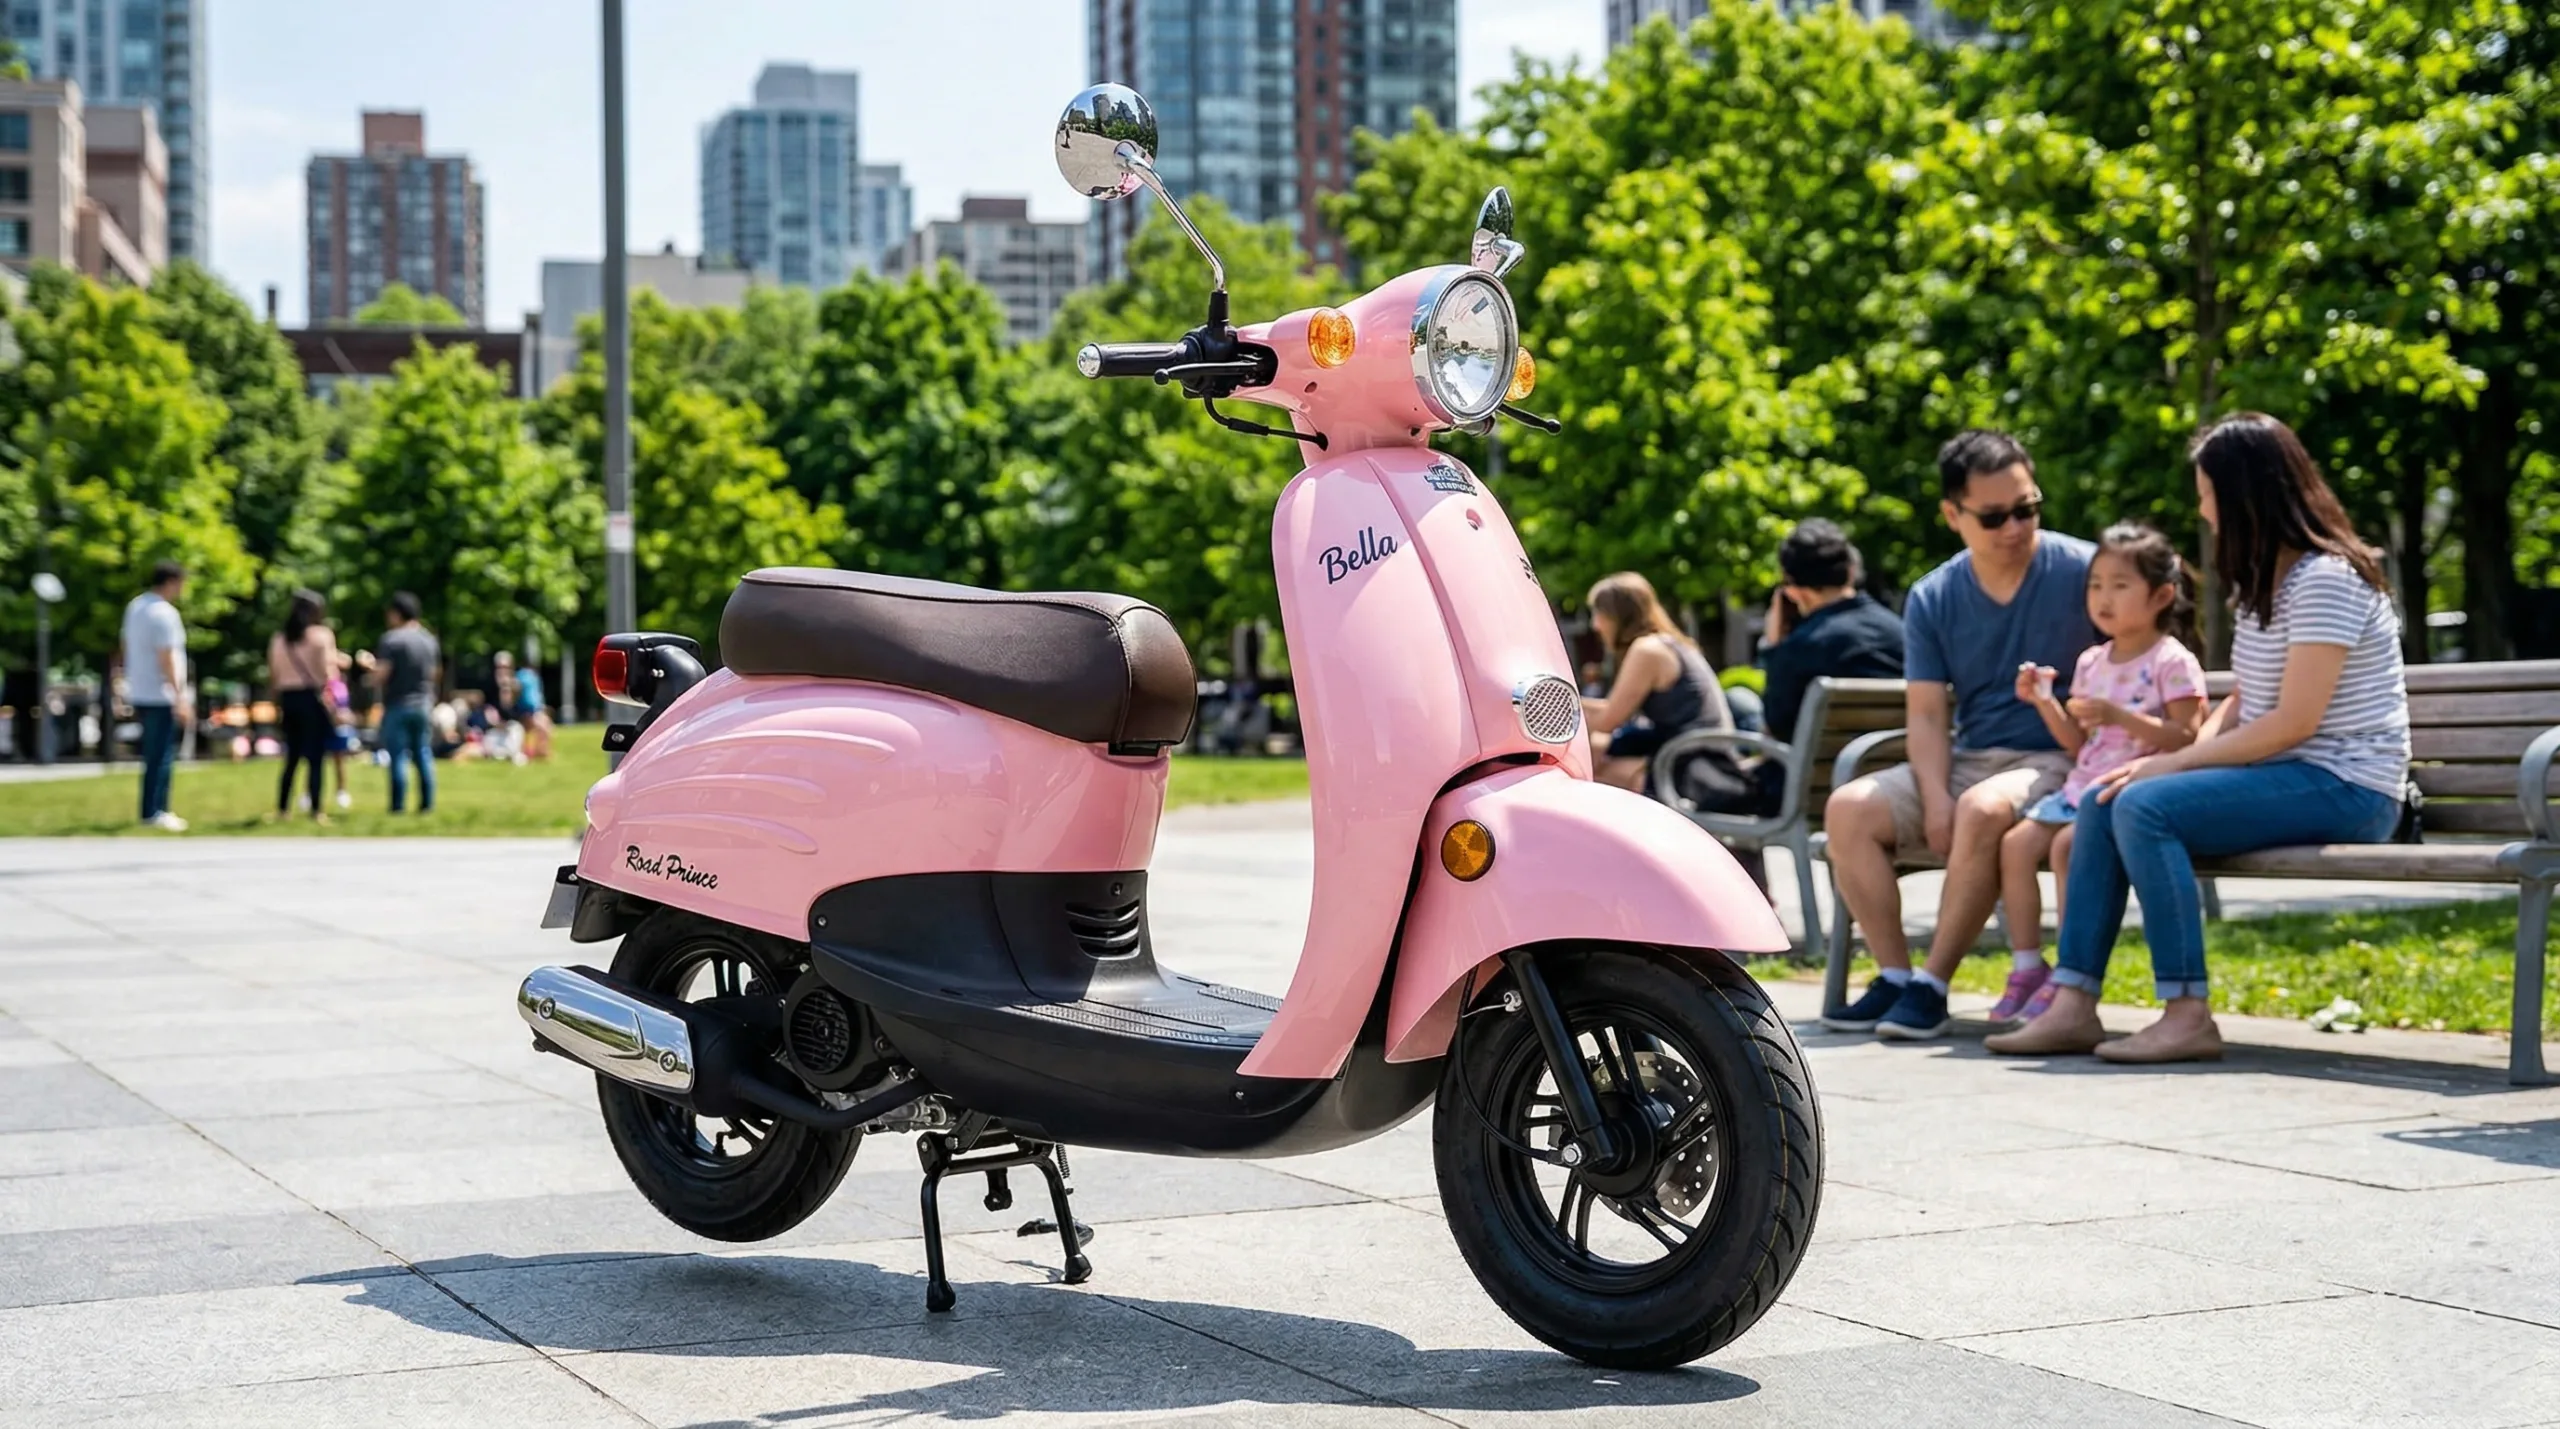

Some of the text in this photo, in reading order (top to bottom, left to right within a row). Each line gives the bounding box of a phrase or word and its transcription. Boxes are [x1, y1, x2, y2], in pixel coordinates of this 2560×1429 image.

[1318, 526, 1398, 584] Bella
[625, 845, 718, 889] Road Prince
